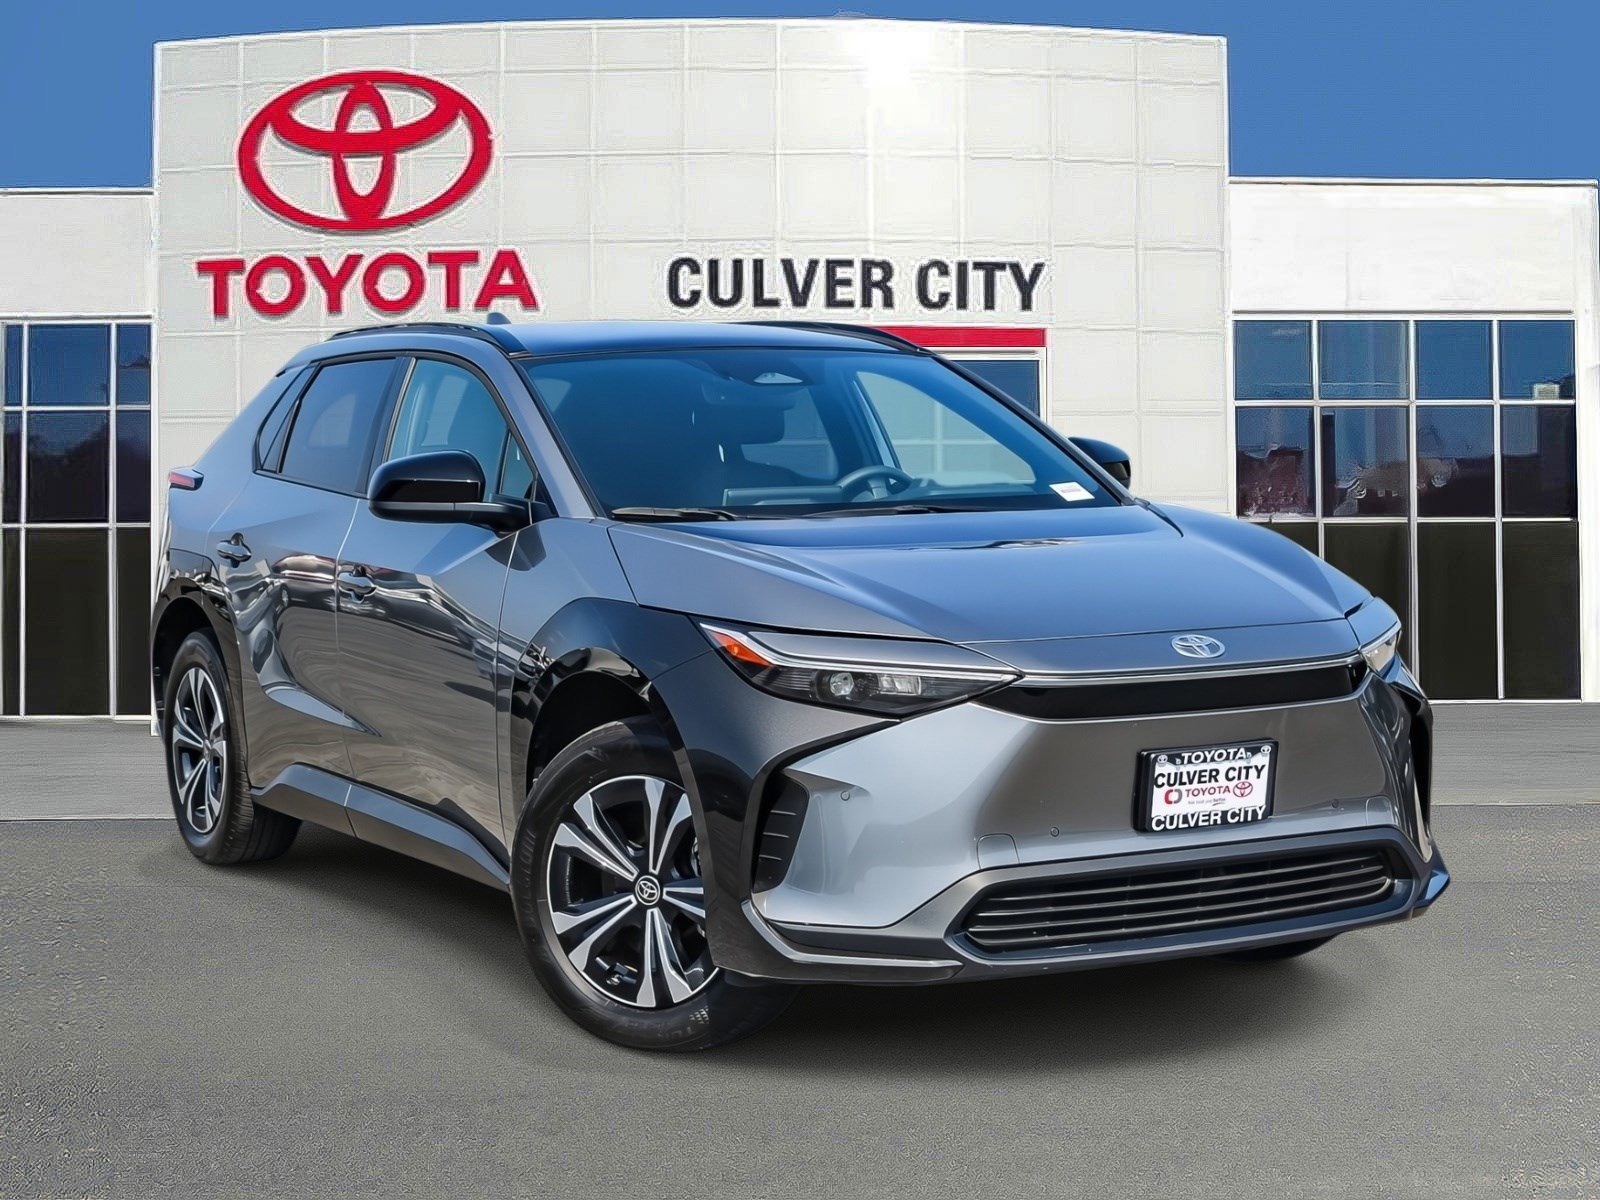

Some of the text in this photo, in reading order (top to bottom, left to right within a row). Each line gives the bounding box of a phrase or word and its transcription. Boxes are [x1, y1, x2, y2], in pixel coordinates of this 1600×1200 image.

[195, 250, 538, 317] TOYOTA
[667, 257, 1046, 311] CULVER CITY
[1181, 748, 1247, 765] TOYOTA
[1154, 764, 1266, 789] CULVER CITY
[1185, 785, 1231, 798] TOYOTA
[1151, 805, 1266, 832] CULVER CITY
